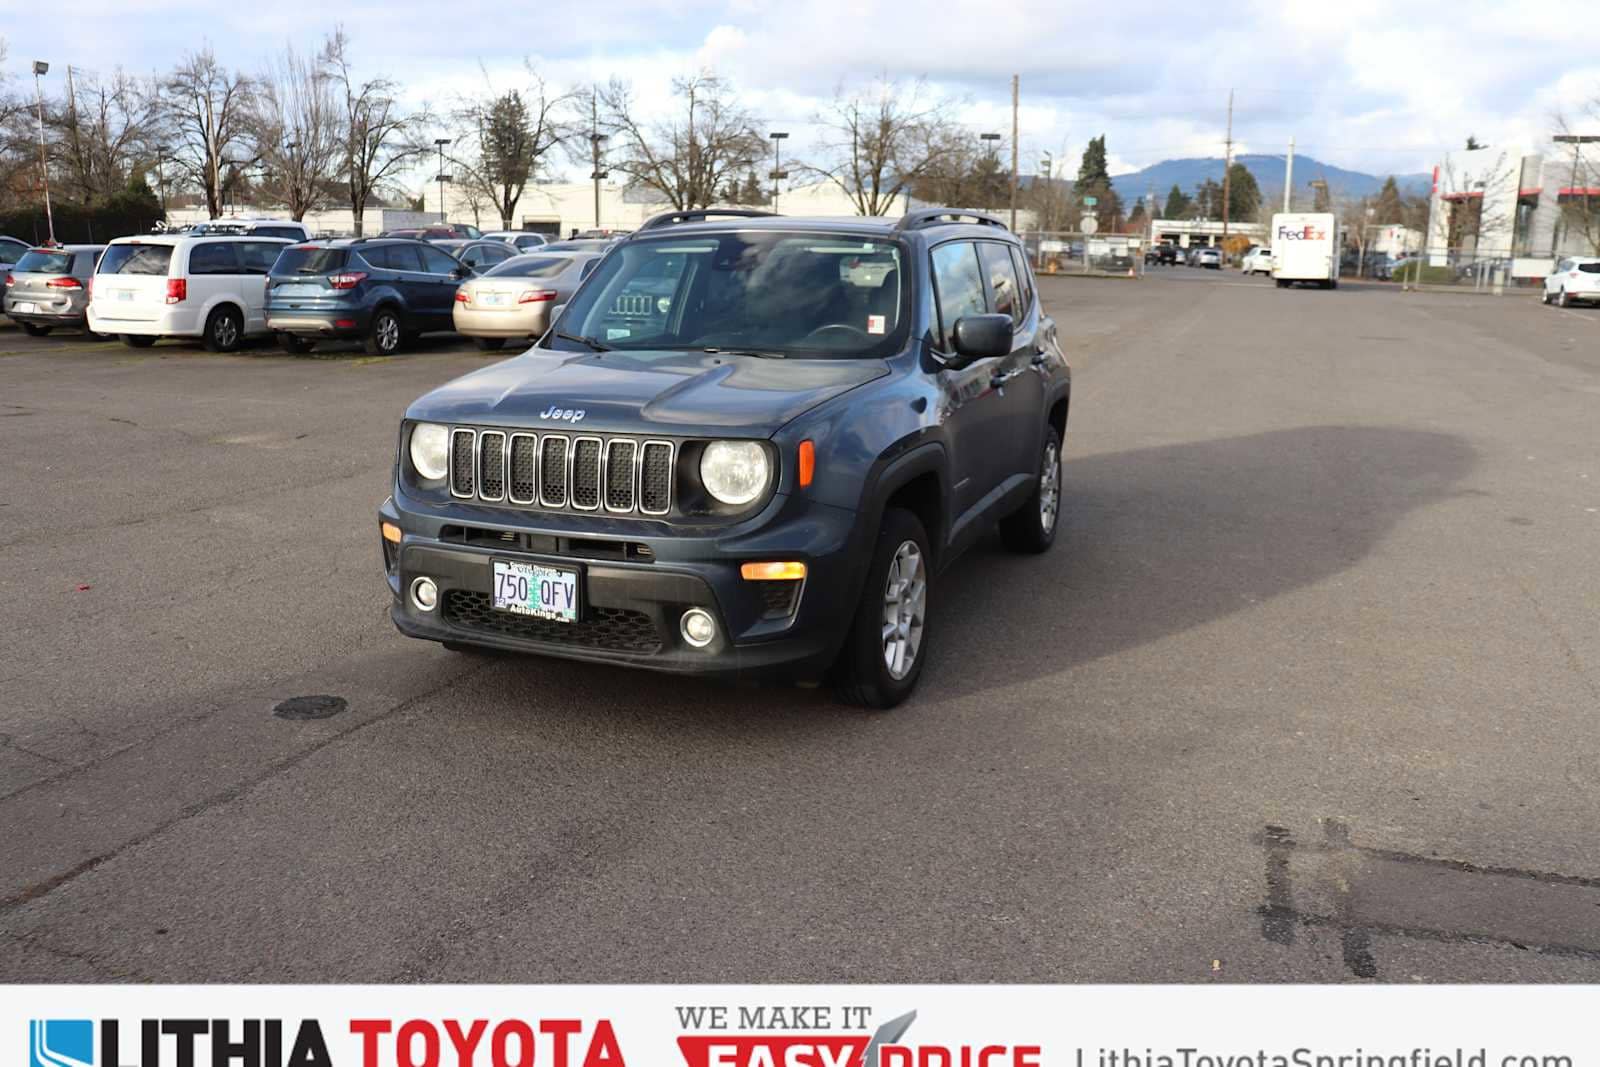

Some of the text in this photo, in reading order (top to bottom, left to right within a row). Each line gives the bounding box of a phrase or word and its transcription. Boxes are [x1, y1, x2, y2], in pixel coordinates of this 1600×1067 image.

[1278, 225, 1326, 241] FedEx
[539, 405, 586, 424] Jeep
[496, 572, 528, 602] 750
[541, 580, 574, 609] QFV
